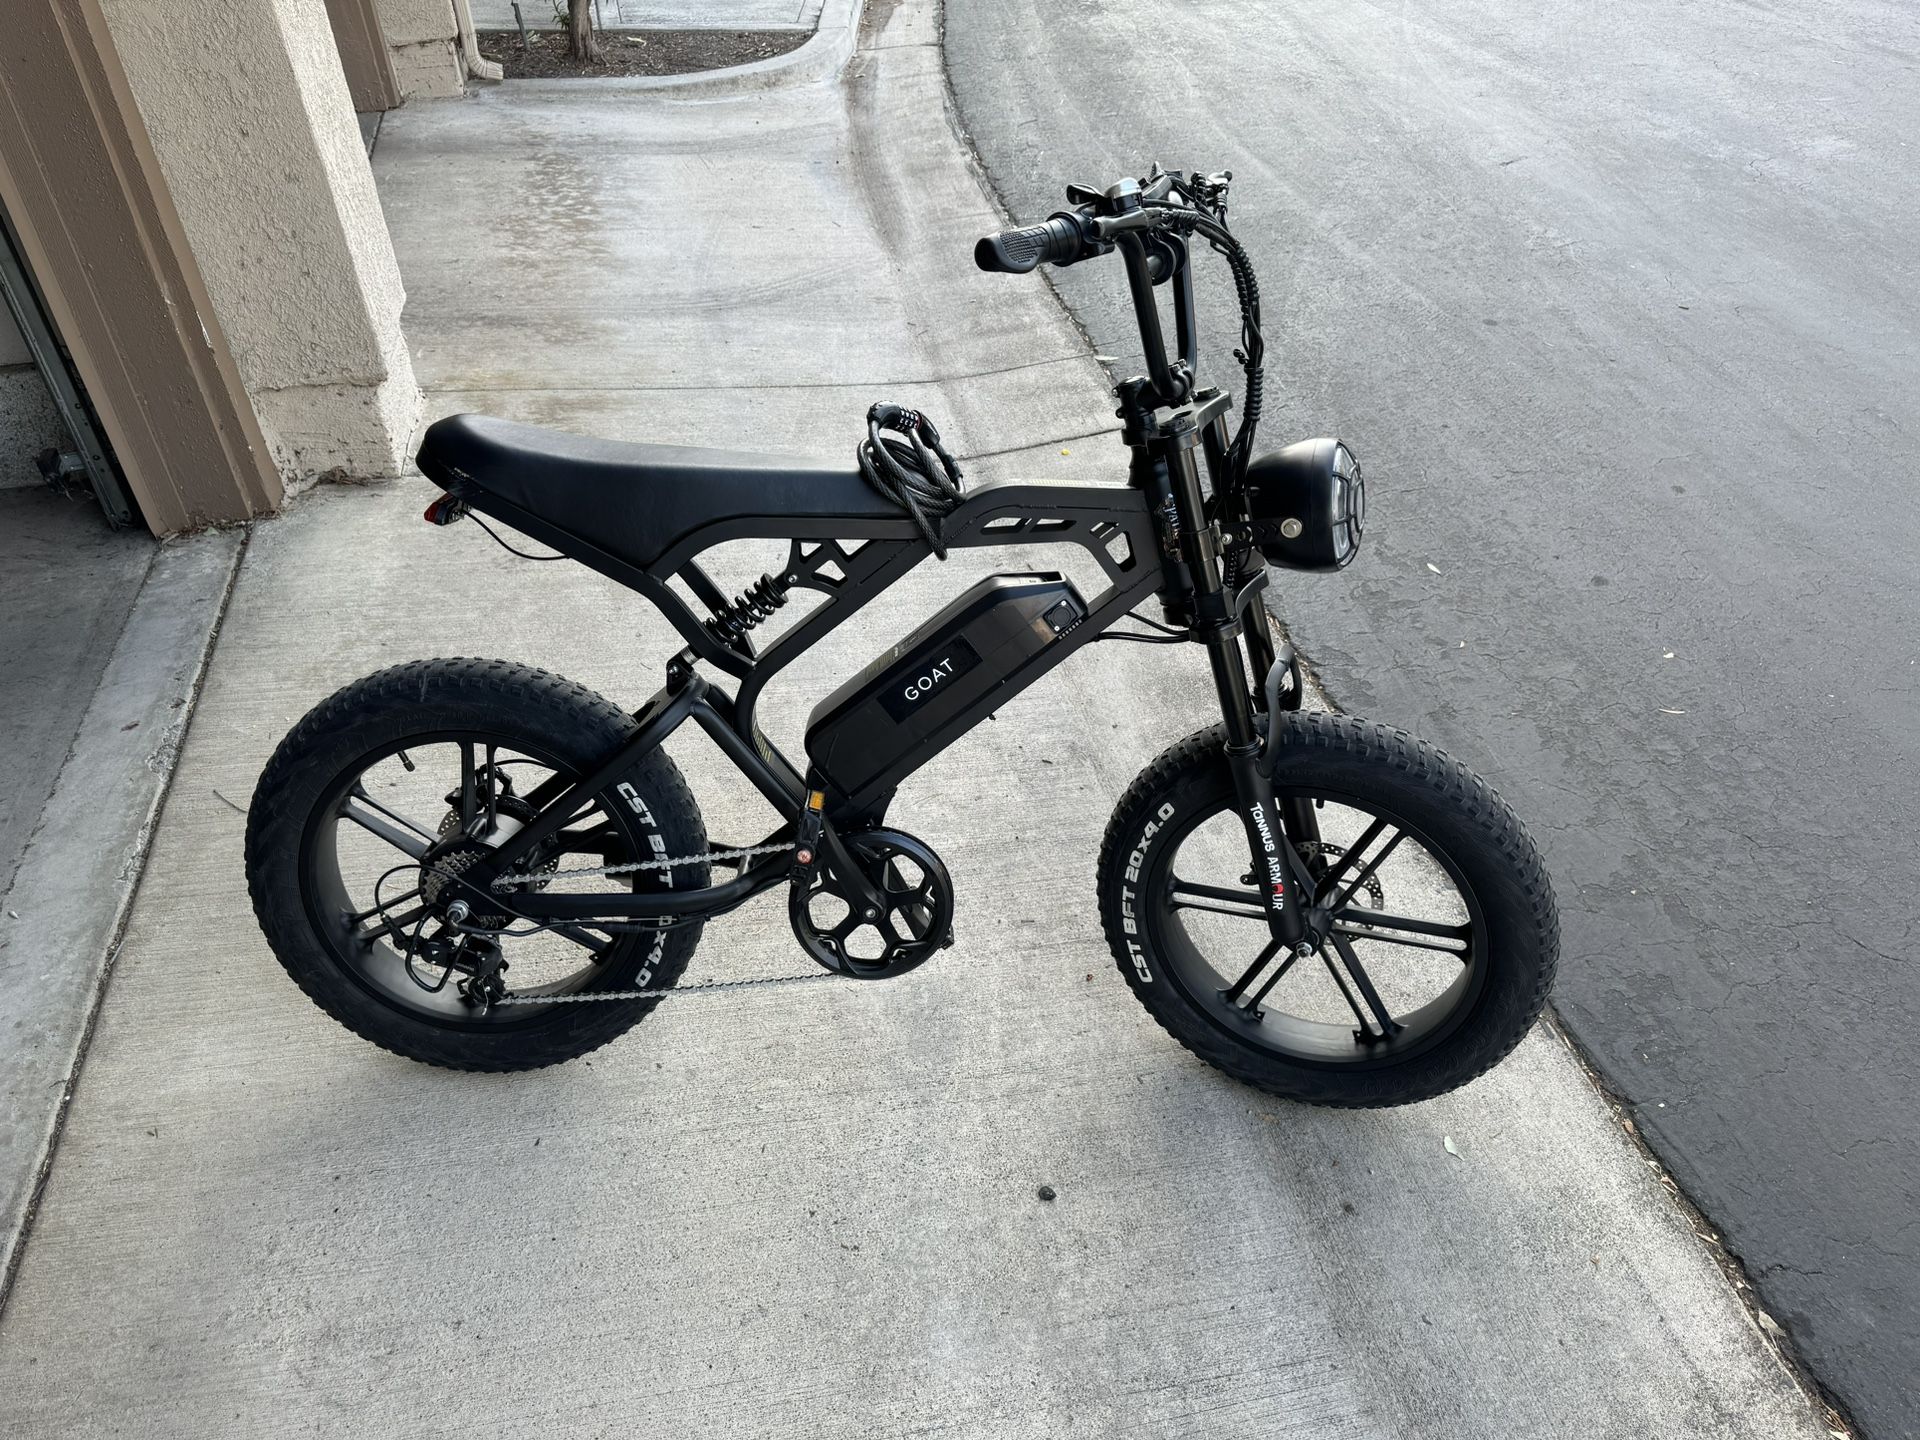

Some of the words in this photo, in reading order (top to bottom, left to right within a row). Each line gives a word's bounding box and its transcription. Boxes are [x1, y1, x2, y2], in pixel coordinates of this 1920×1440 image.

[904, 658, 953, 700] GOAT
[616, 782, 657, 828] CST
[1267, 856, 1284, 911] ARMOUR
[1122, 885, 1138, 935] BFT
[1126, 940, 1153, 983] CST
